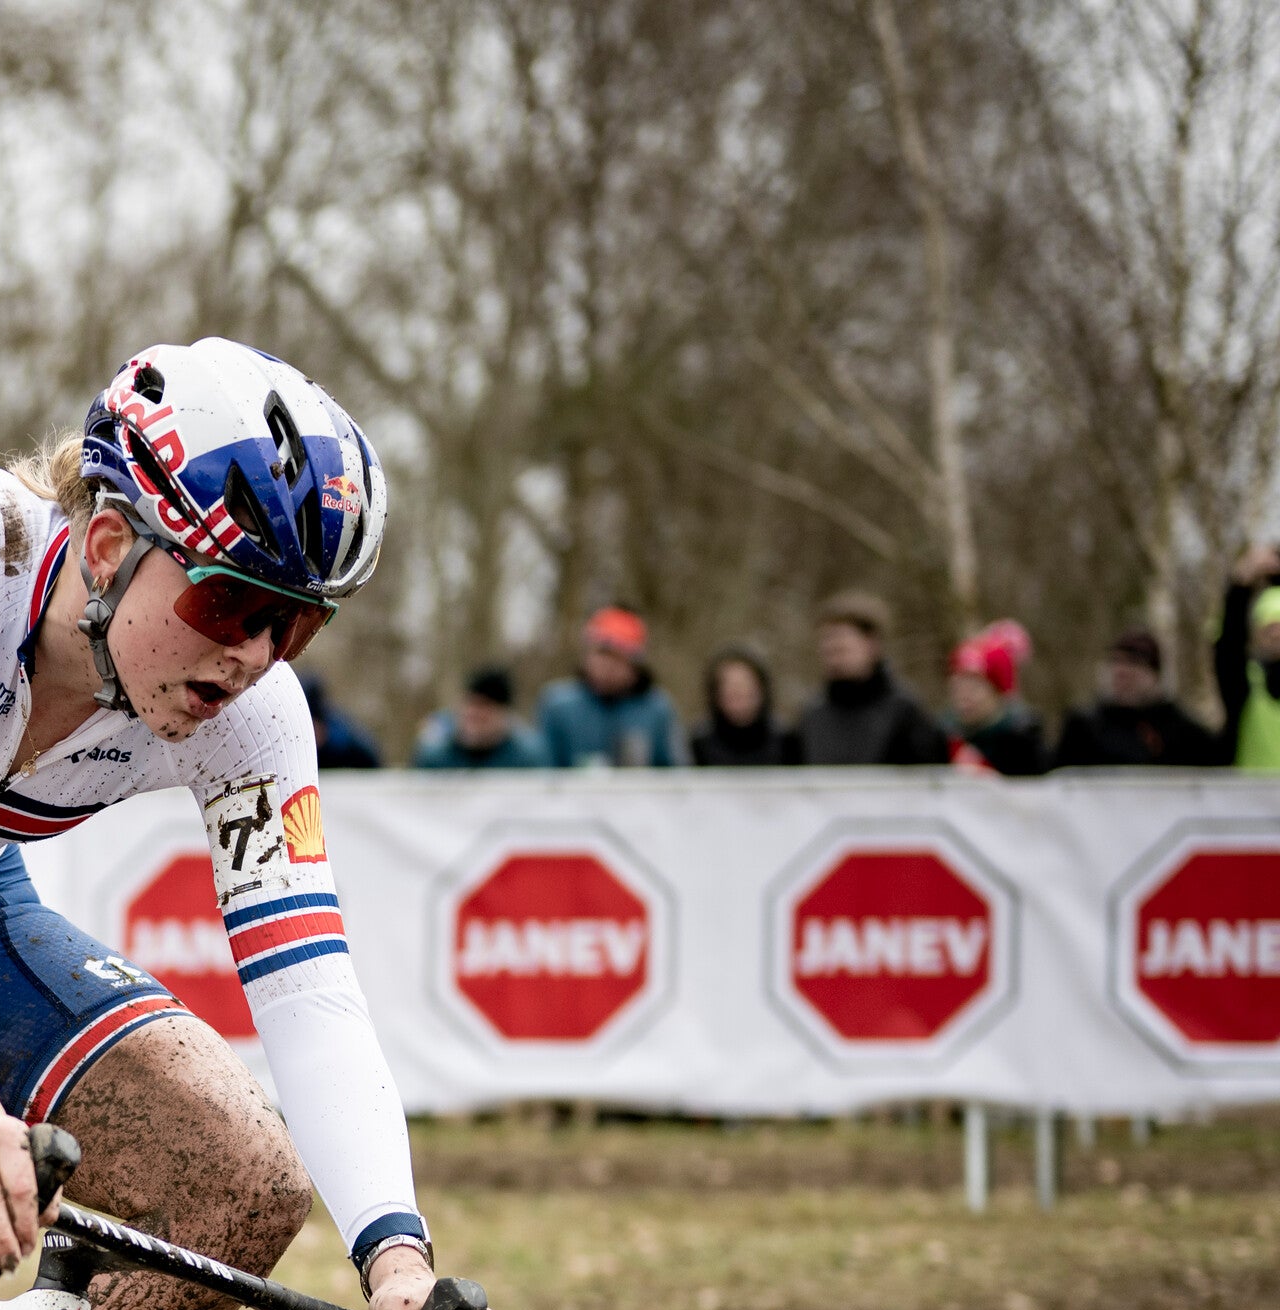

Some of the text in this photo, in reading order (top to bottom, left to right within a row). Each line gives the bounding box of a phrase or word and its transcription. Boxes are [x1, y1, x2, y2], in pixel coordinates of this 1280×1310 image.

[322, 493, 344, 511] Red
[457, 918, 640, 977] JANEV
[794, 917, 987, 976] JANEV
[1141, 918, 1280, 979] JANE
